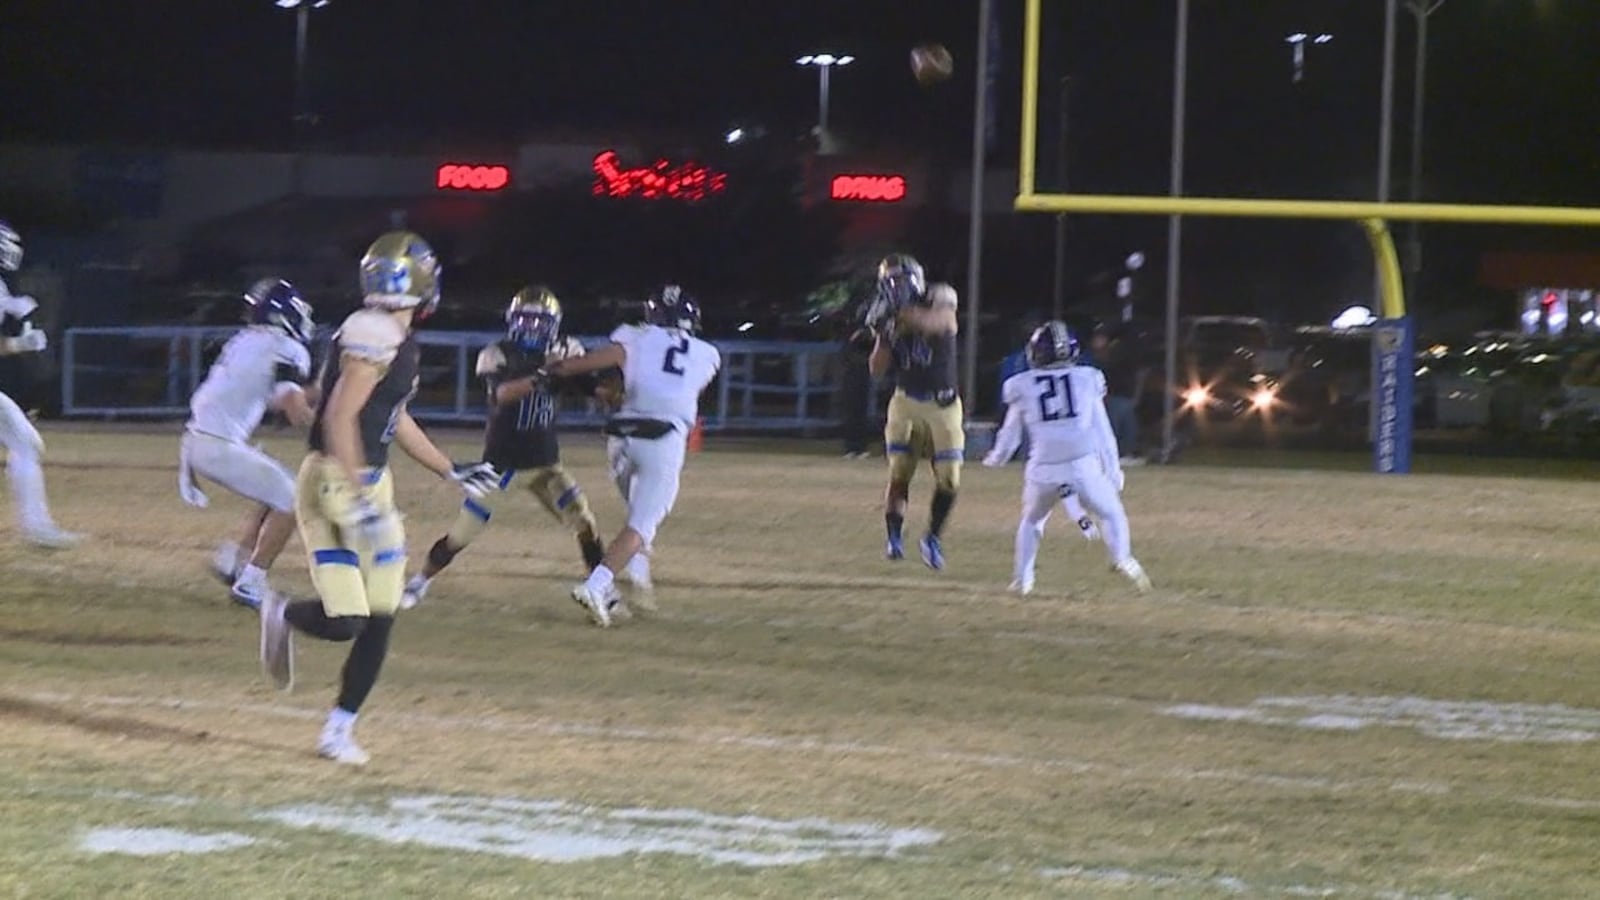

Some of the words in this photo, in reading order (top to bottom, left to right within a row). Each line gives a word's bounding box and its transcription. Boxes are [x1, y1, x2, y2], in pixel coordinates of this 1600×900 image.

[437, 164, 509, 190] FOOD
[662, 338, 689, 376] 2
[1034, 373, 1078, 421] 21
